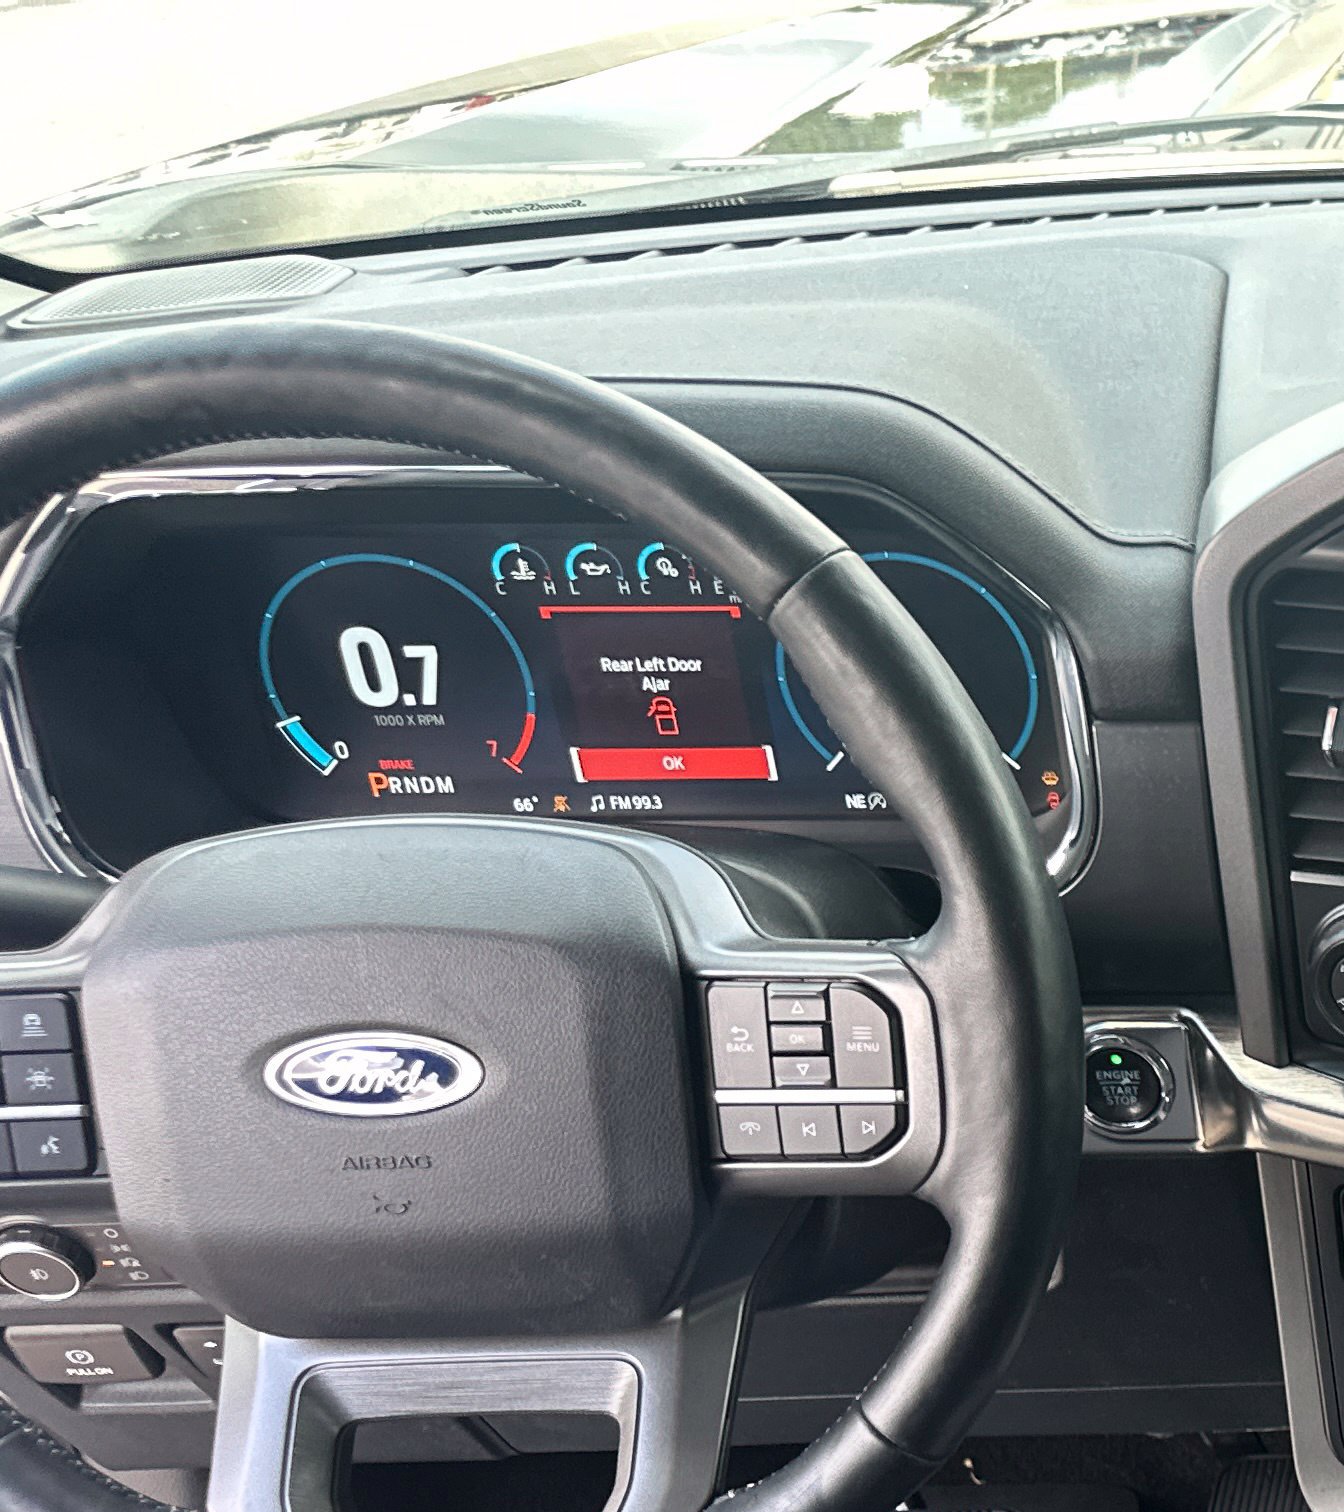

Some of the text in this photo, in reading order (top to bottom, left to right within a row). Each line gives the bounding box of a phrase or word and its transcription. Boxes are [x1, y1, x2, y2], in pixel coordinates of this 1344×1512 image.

[495, 581, 508, 595] C
[543, 580, 557, 596] H
[570, 581, 581, 596] L
[617, 581, 631, 595] H
[640, 581, 651, 595] C
[689, 580, 702, 595] H
[339, 626, 439, 708] 0.7
[600, 656, 702, 673] Rear Left Door
[641, 675, 671, 694] Ajar
[373, 714, 446, 727] 1000 X RPM
[333, 740, 350, 760] 0
[486, 739, 498, 758] 7
[378, 759, 416, 771] BRAKE
[661, 755, 687, 771] OK
[609, 794, 663, 811] FM 99.3
[843, 793, 867, 810] NE
[788, 1034, 805, 1045] OK
[846, 1041, 880, 1053] MENU
[725, 1042, 755, 1053] BACK
[298, 1048, 440, 1099] Ford
[1095, 1070, 1141, 1080] ENGINE
[1101, 1086, 1139, 1096] START
[1105, 1096, 1137, 1106] STOP
[341, 1154, 434, 1172] AIRBAG
[65, 1367, 114, 1376] PULL ON
